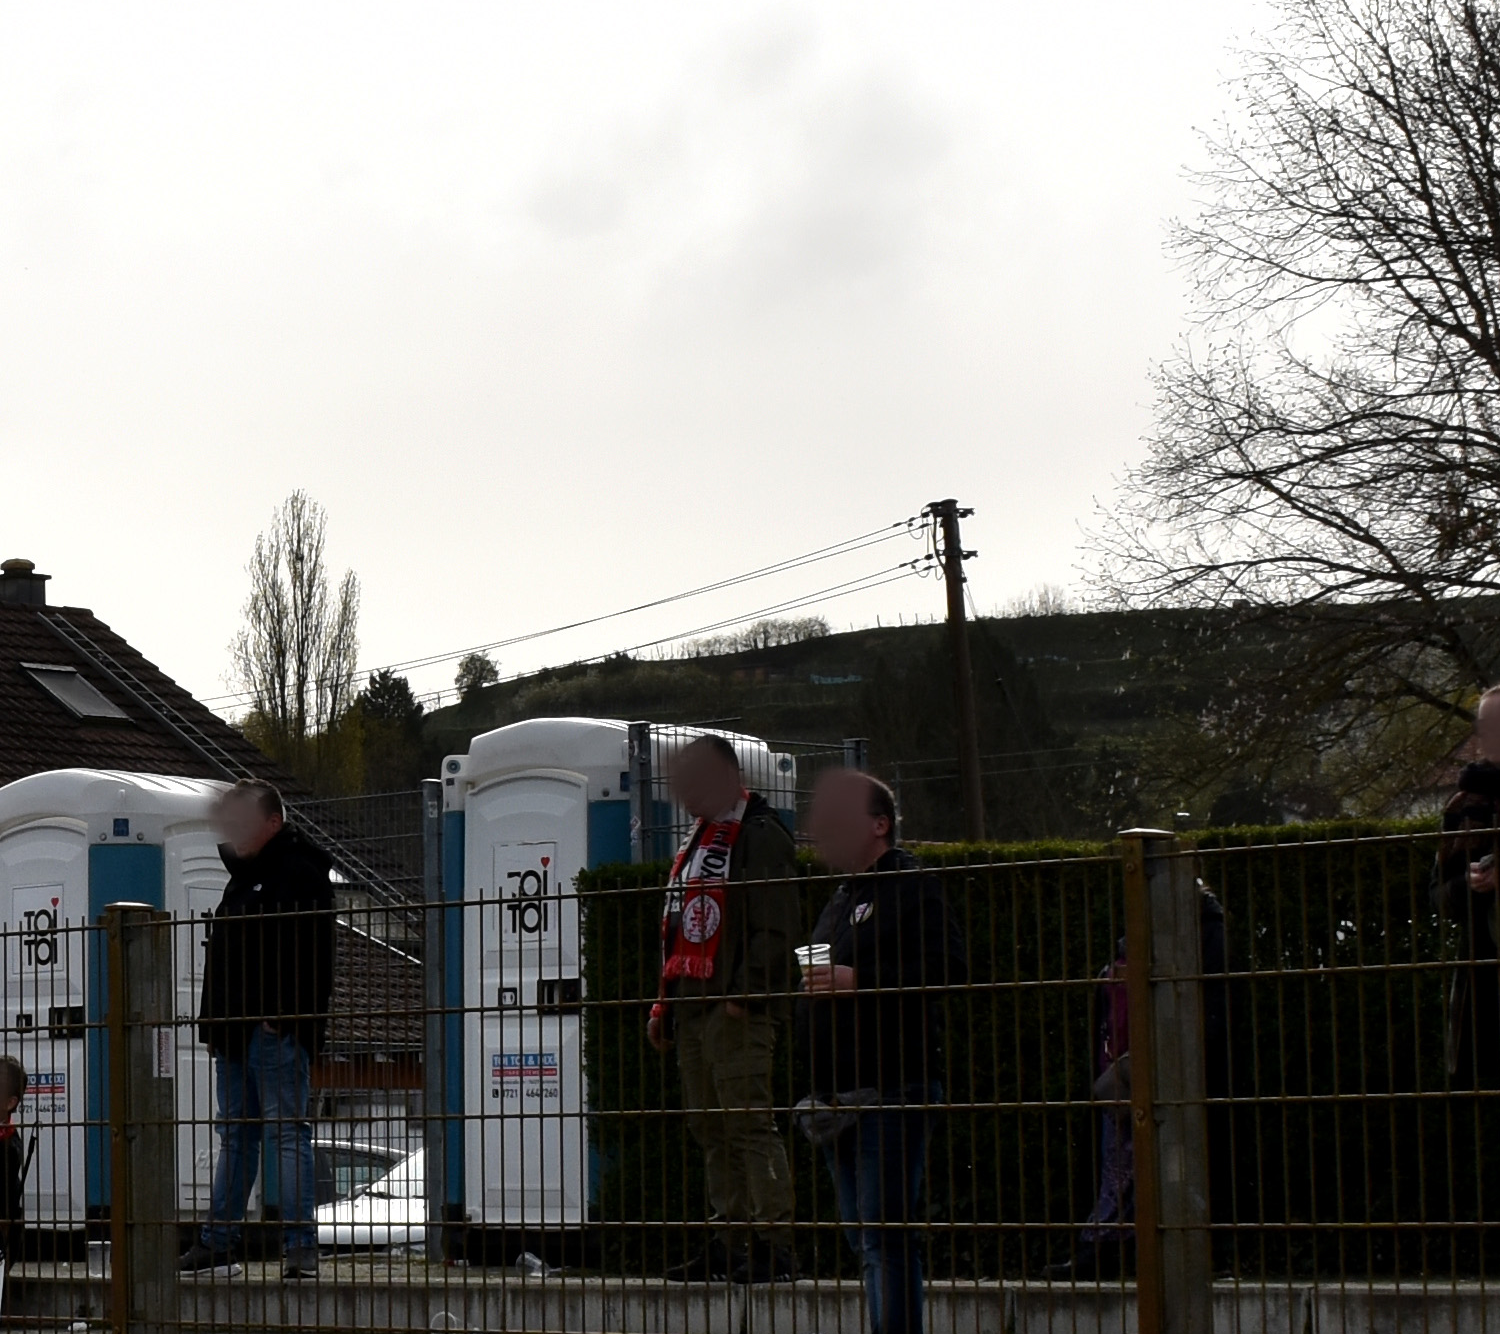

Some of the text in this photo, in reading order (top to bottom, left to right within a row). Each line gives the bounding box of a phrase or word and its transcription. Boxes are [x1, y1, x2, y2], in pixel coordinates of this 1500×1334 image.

[24, 908, 57, 937] TOI
[507, 903, 547, 933] TOI
[24, 937, 57, 965] TOI
